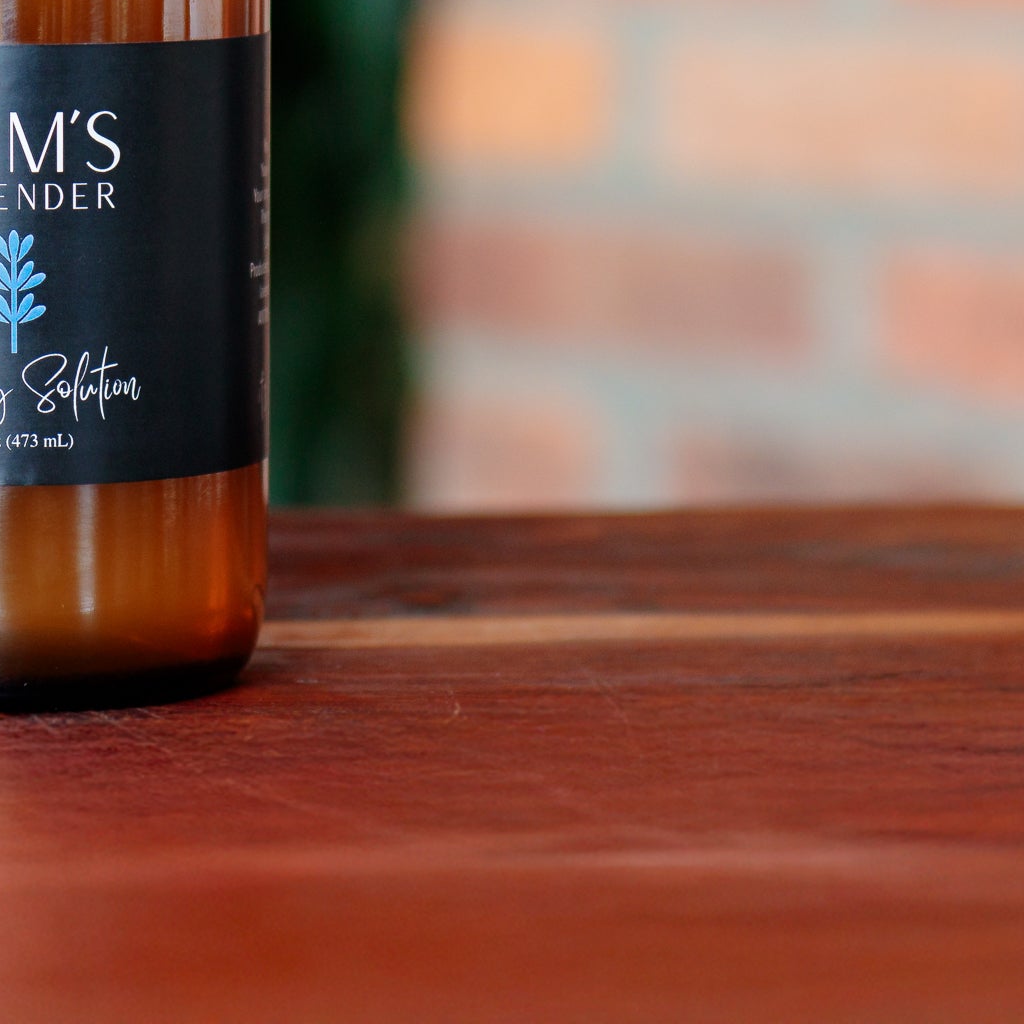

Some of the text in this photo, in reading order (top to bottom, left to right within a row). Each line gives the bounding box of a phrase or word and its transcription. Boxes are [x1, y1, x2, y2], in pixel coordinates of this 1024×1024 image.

[21, 345, 142, 422] Solution
[5, 433, 39, 451] (473
[43, 433, 75, 451] mL)
